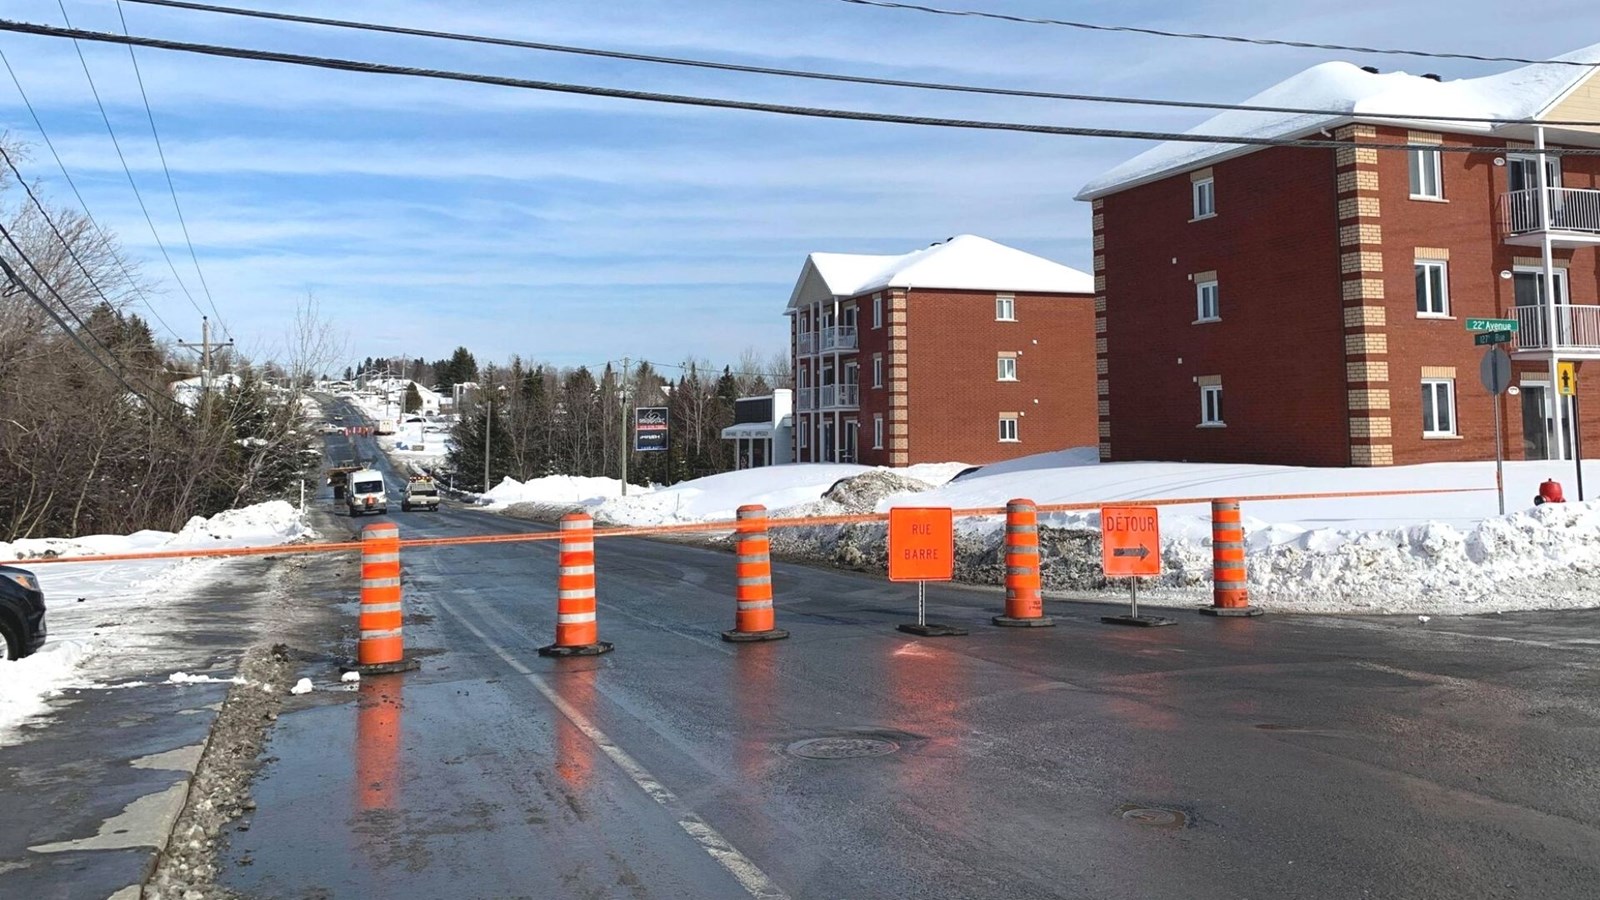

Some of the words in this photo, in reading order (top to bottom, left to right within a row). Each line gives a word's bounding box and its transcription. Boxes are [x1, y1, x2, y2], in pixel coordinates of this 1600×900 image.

[1485, 321, 1512, 330] Avenue
[1106, 512, 1155, 532] DÉTOUR
[912, 523, 932, 535] RUE
[904, 549, 938, 560] BARRE
